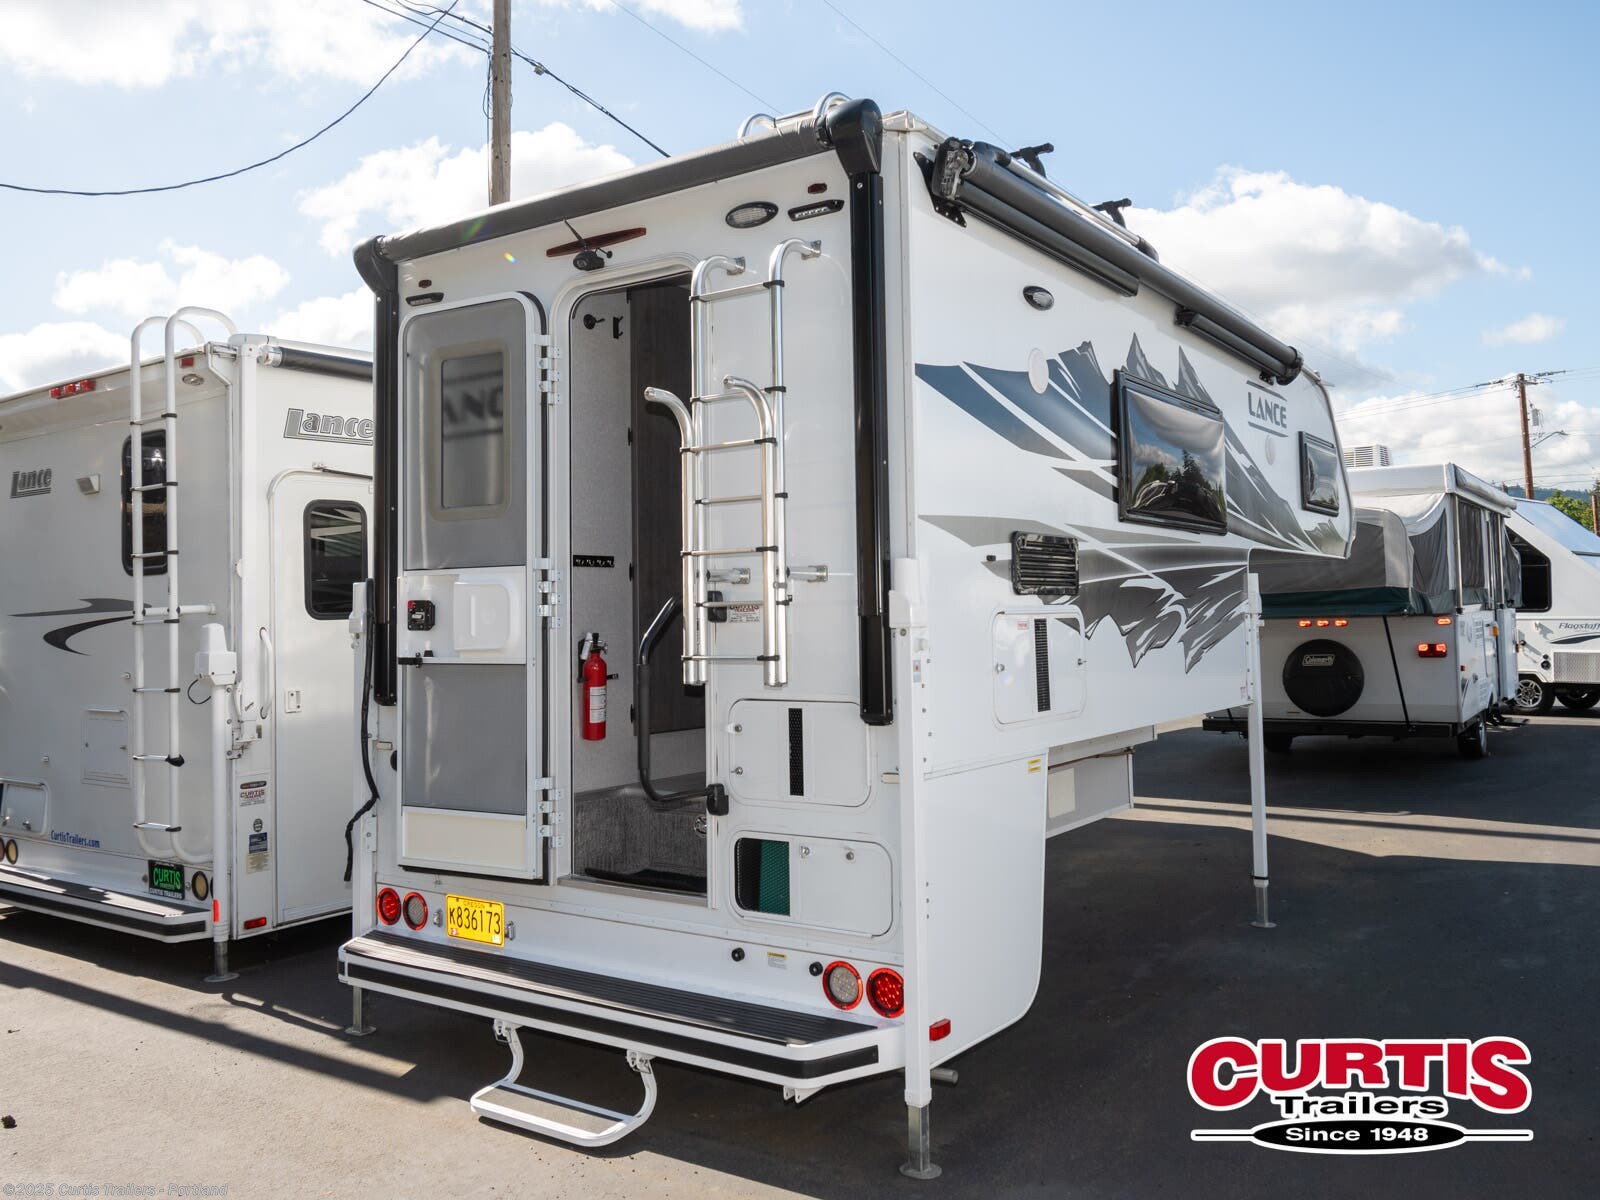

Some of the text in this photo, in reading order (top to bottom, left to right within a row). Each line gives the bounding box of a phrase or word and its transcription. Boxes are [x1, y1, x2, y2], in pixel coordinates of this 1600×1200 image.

[1247, 391, 1288, 429] LANCE
[283, 407, 376, 446] Lance
[10, 468, 52, 499] Lance
[153, 867, 181, 890] CURTIS
[449, 906, 501, 935] K836173
